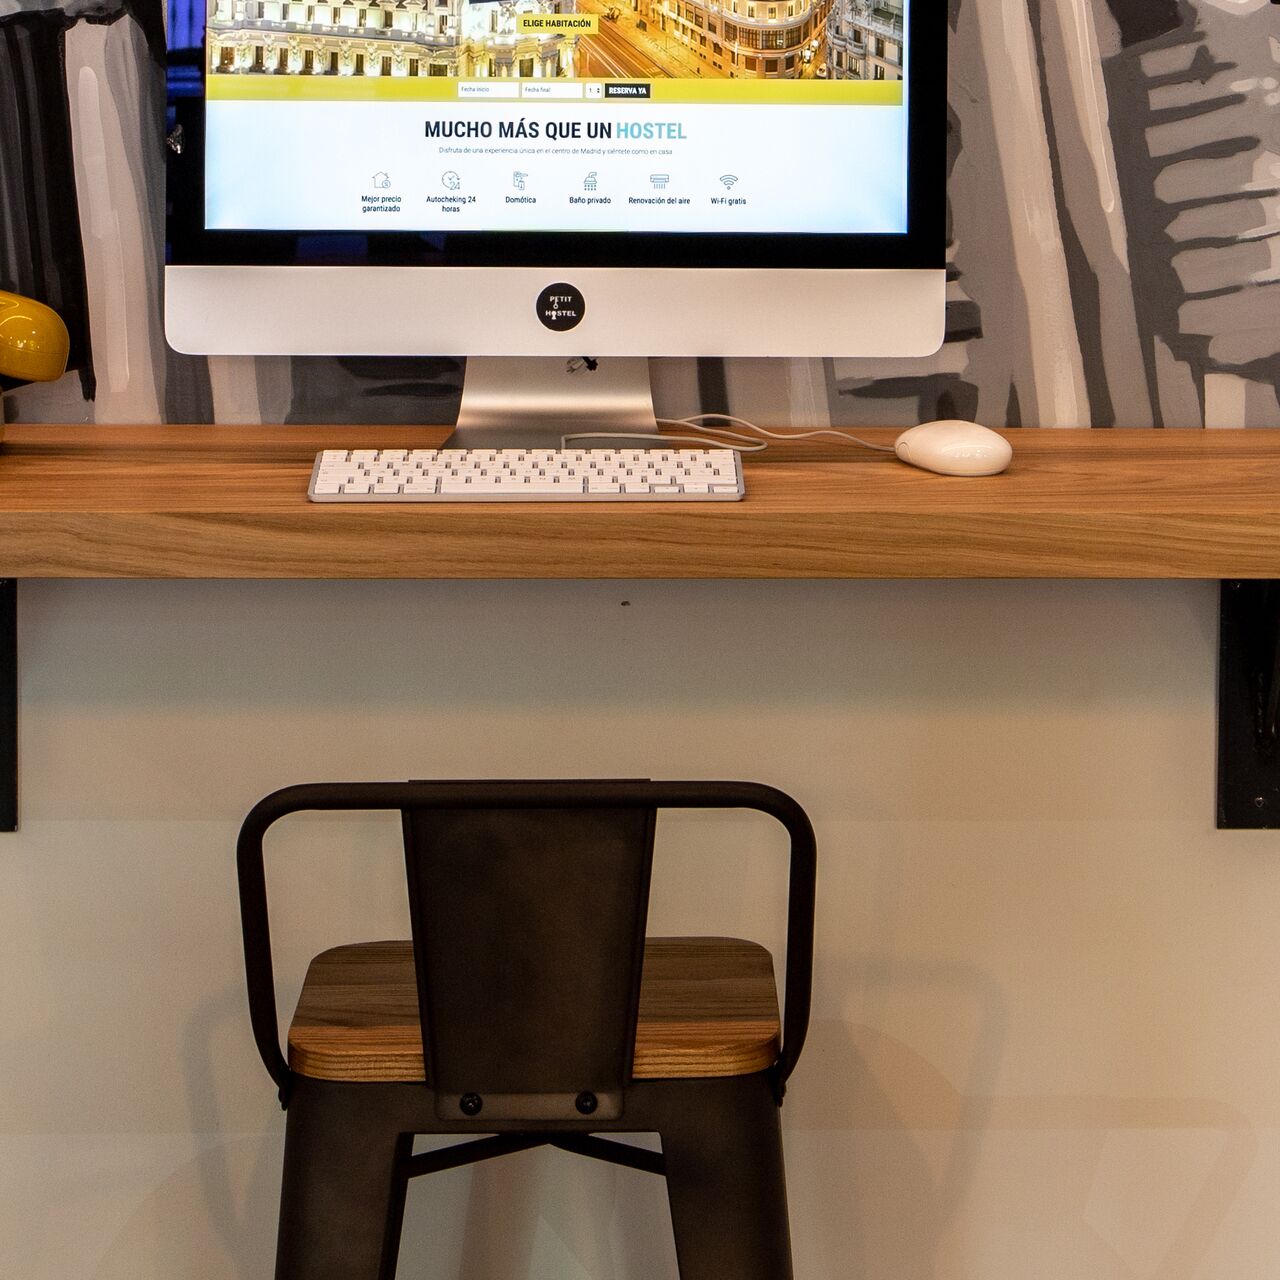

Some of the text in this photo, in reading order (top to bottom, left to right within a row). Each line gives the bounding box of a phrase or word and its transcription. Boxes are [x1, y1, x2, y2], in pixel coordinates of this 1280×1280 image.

[523, 18, 592, 28] ELIGE HABITACIÓN
[608, 87, 647, 95] RESERVA YA
[424, 117, 688, 141] MUCHO MÁS QUE UN HOSTEL
[580, 147, 601, 155] Madrid
[361, 195, 402, 204] Mejor precio
[426, 195, 476, 204] Autocheking 24
[505, 195, 537, 204] Domótica
[569, 196, 612, 205] Baño privado
[628, 196, 667, 205] Renovación
[678, 197, 691, 205] aire
[710, 197, 747, 206] Wi-Fi gratis
[362, 205, 401, 213] garantizado
[442, 205, 460, 213] horas
[550, 296, 572, 306] PETIT
